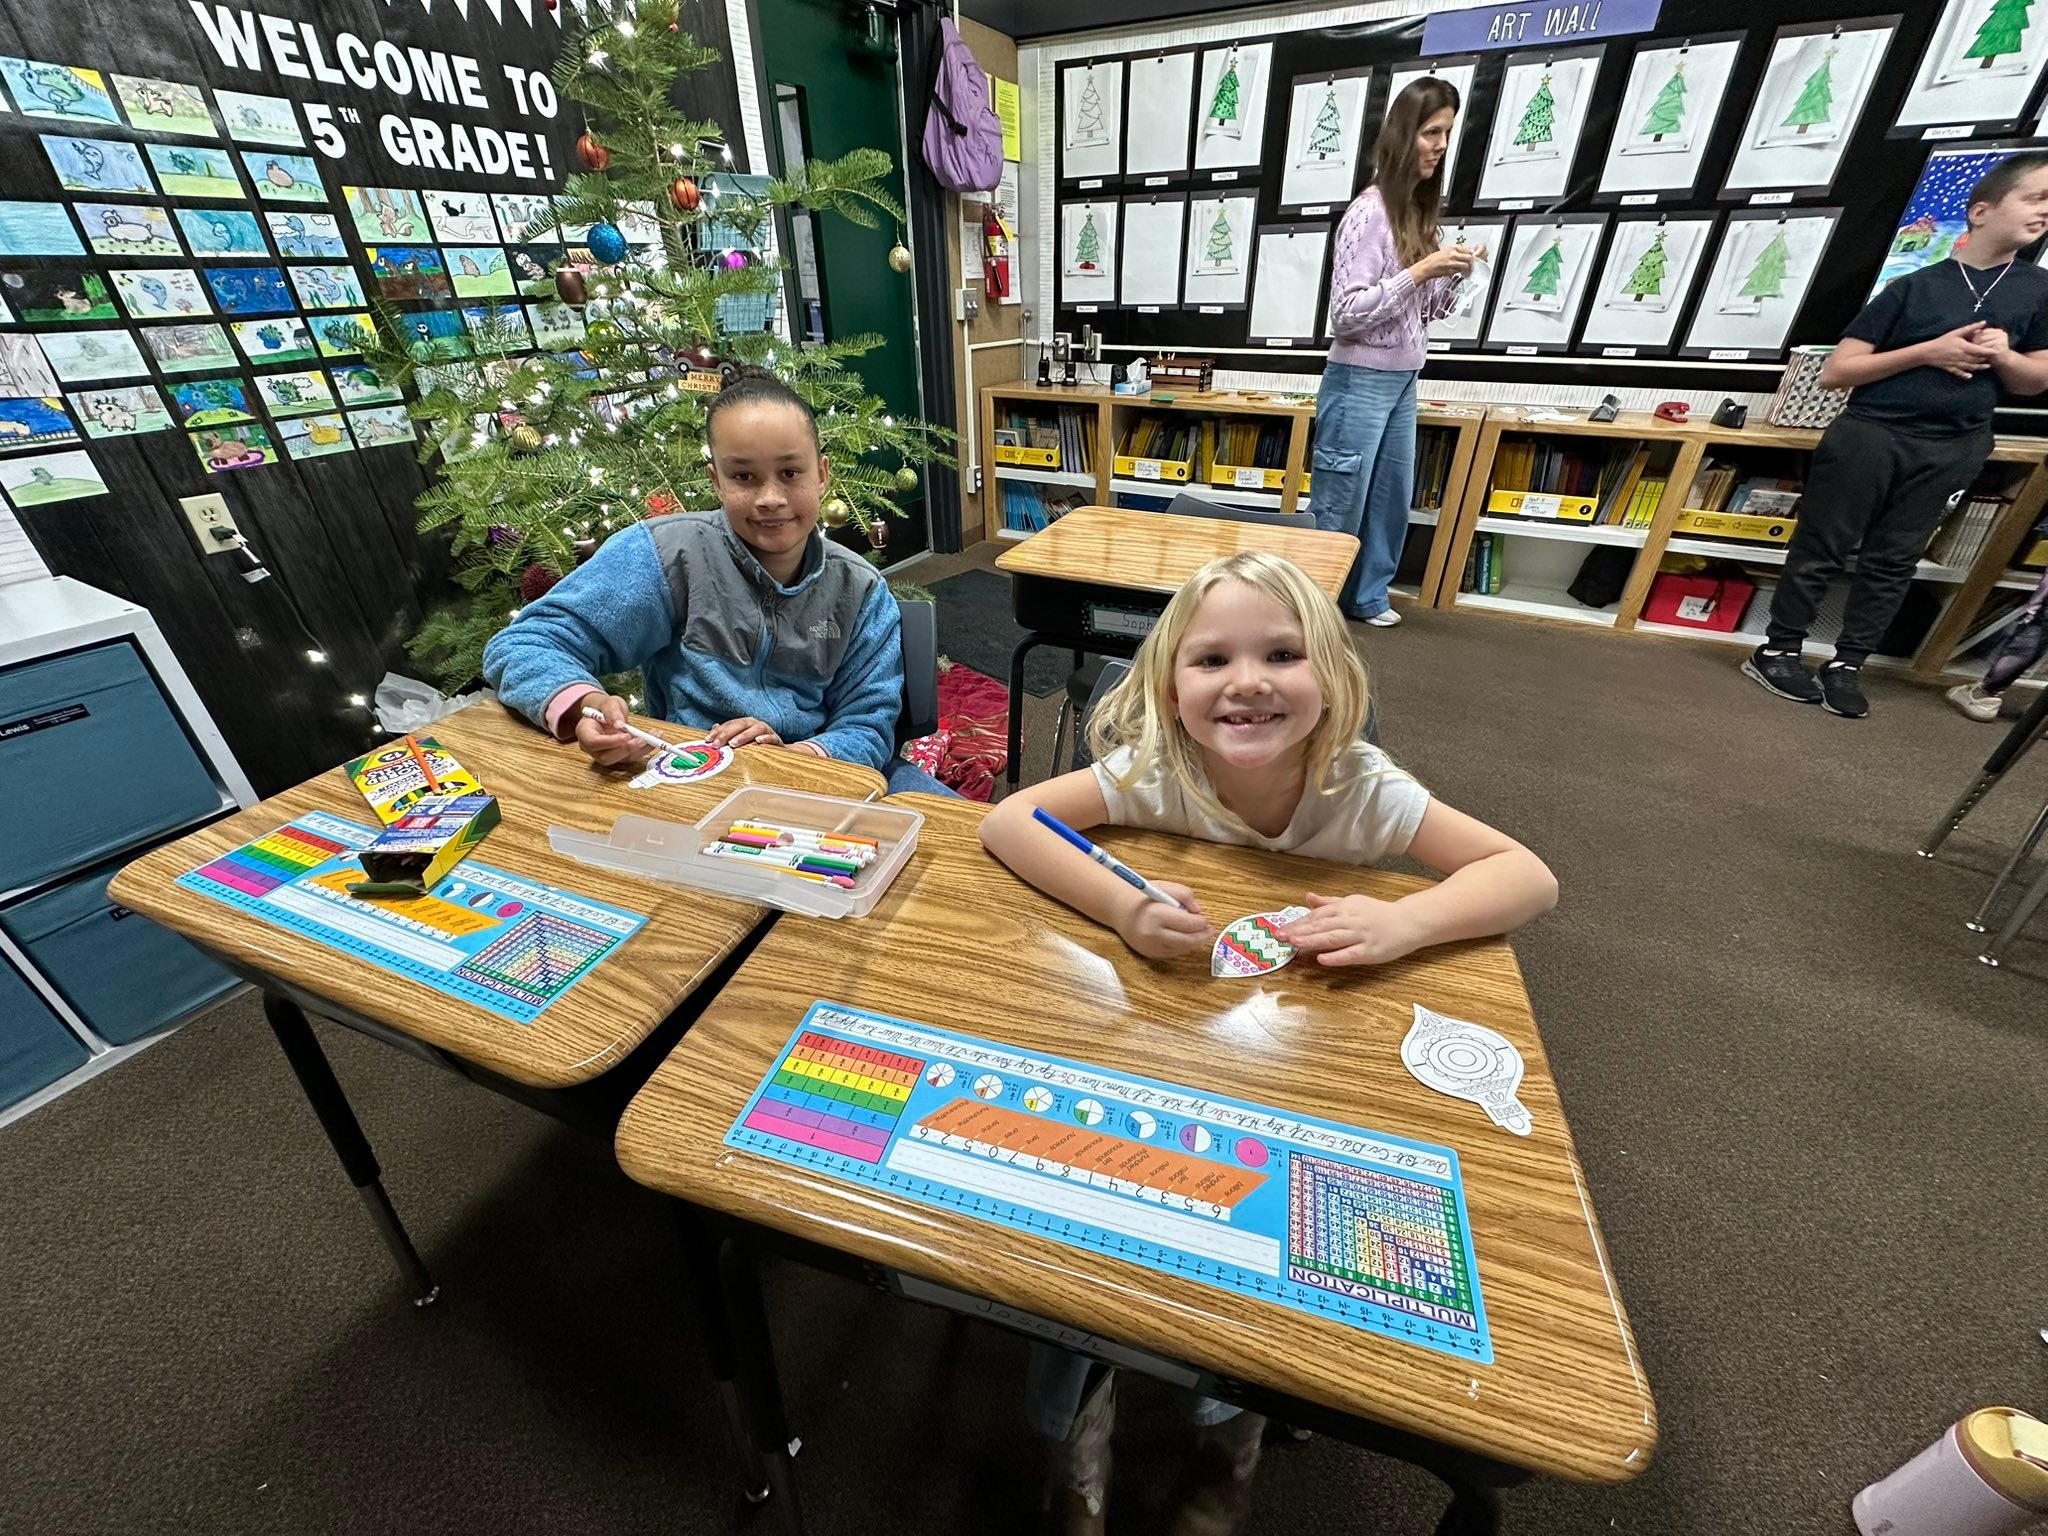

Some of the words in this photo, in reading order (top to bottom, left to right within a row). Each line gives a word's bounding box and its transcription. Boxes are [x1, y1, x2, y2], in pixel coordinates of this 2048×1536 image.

[1487, 12, 1532, 42] ART
[1544, 2, 1601, 36] WALL
[189, 0, 489, 109] WELCOME
[503, 65, 558, 118] TO
[379, 114, 555, 180] GRADE!
[690, 372, 720, 382] MERRY
[681, 382, 720, 391] CHRISTM
[0, 724, 30, 737] Lewis
[382, 752, 402, 762] 12
[453, 966, 544, 1006] MULTIPLICATION
[1292, 1267, 1472, 1327] MULTIPLICATION
[1297, 1289, 1308, 1297] -12
[1318, 1295, 1329, 1303] -13
[1339, 1301, 1350, 1309] -14
[1360, 1307, 1372, 1315] -15
[1382, 1313, 1394, 1322] -16
[976, 1302, 1104, 1352] Joseph
[1426, 1325, 1438, 1334] -18
[1448, 1331, 1461, 1340] -19
[1470, 1338, 1484, 1347] -20
